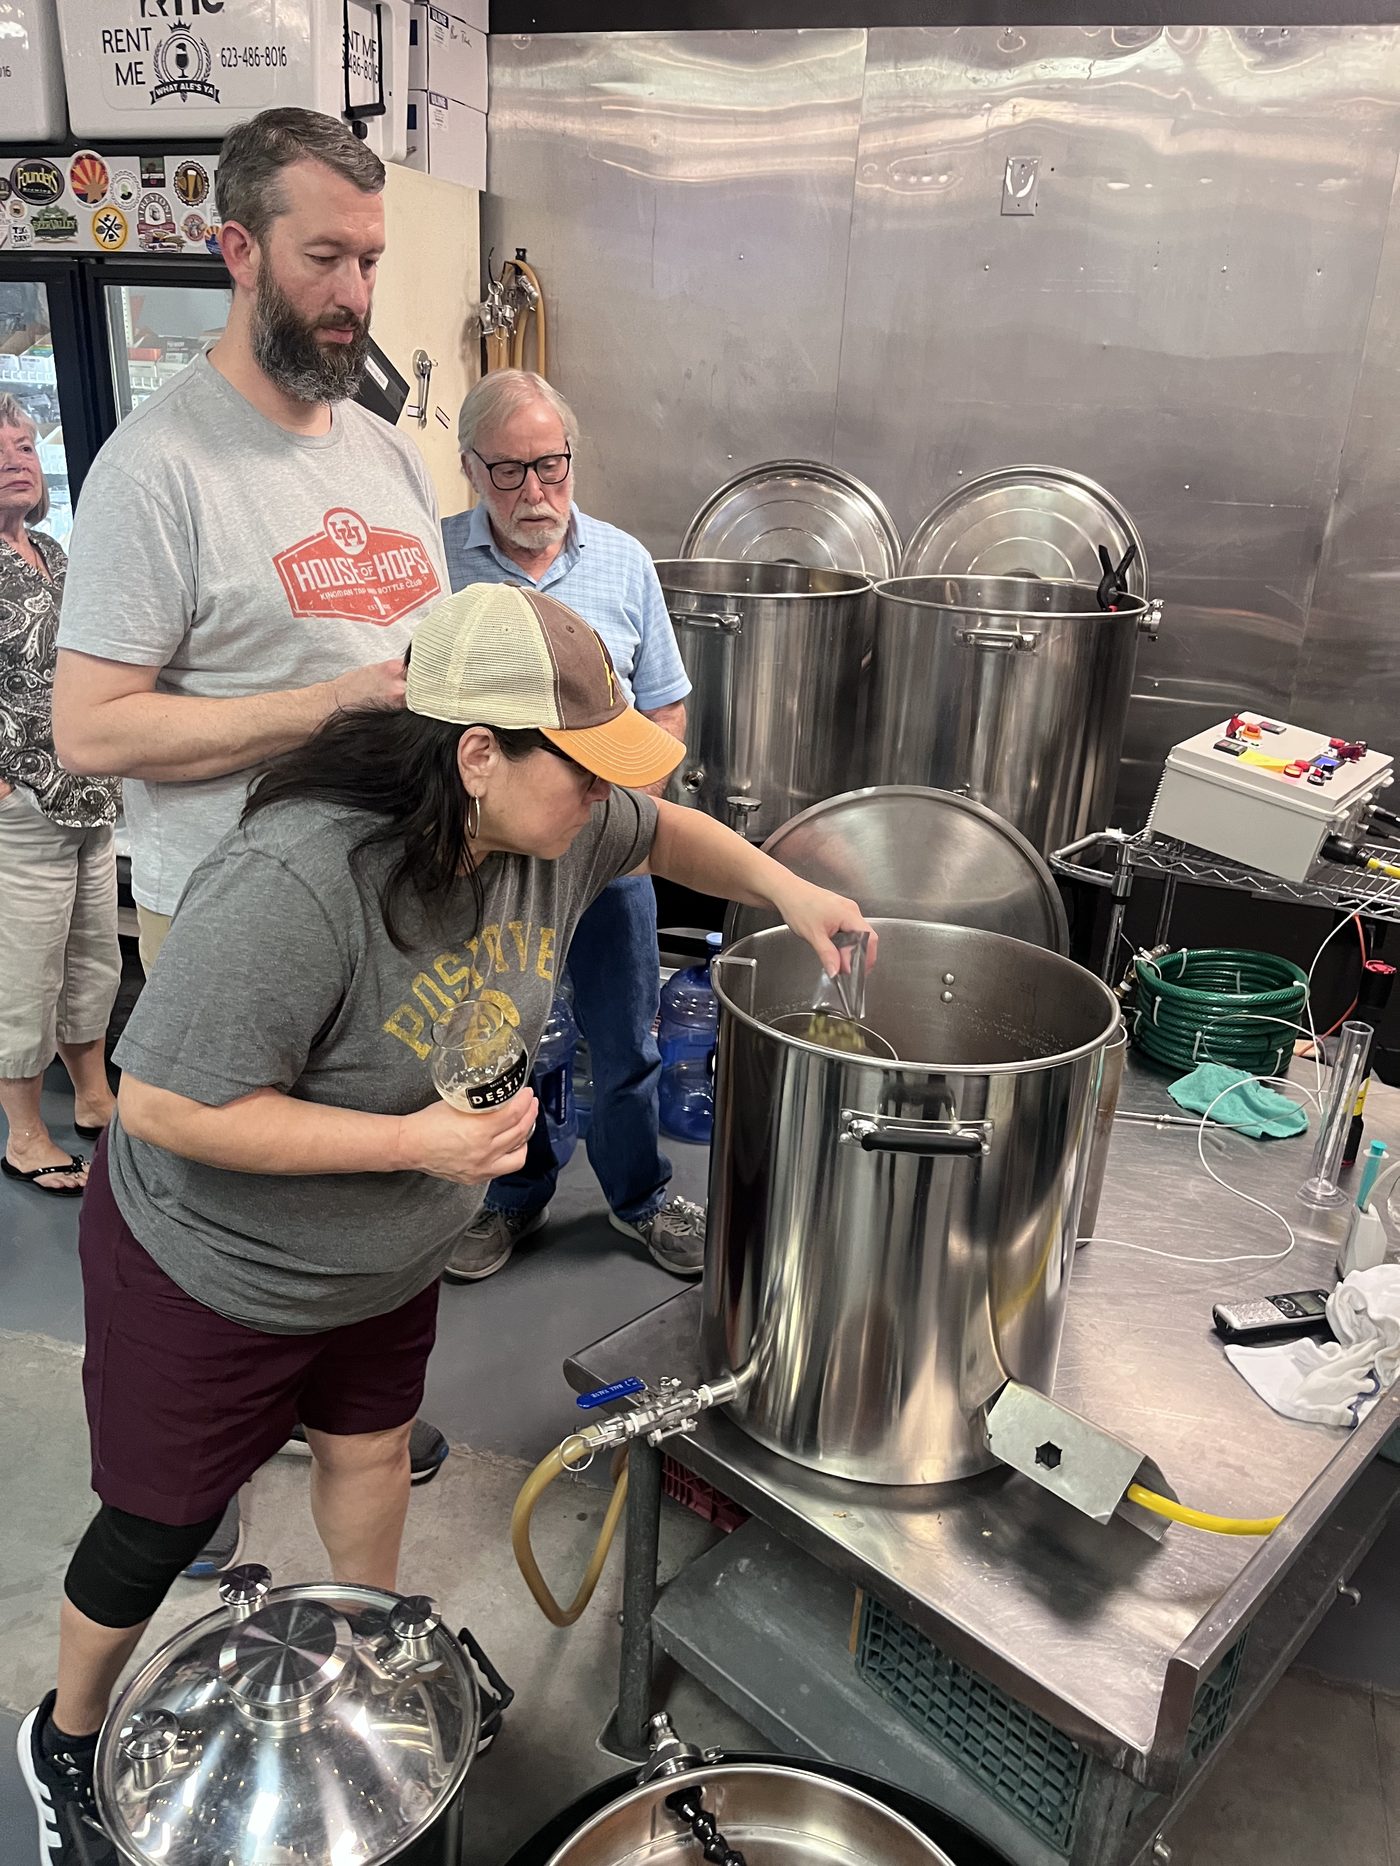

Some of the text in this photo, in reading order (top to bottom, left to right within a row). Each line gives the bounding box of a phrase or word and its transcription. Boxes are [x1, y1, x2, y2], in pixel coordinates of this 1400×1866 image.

[102, 27, 152, 54] RENT
[220, 46, 288, 68] 623-486-8016
[115, 61, 146, 87] ME
[156, 82, 214, 96] WHAT ALE'S YA
[291, 546, 430, 593] HOUSE OF HOPS
[320, 588, 354, 601] KINGMAN
[377, 583, 405, 596] BOTTLE
